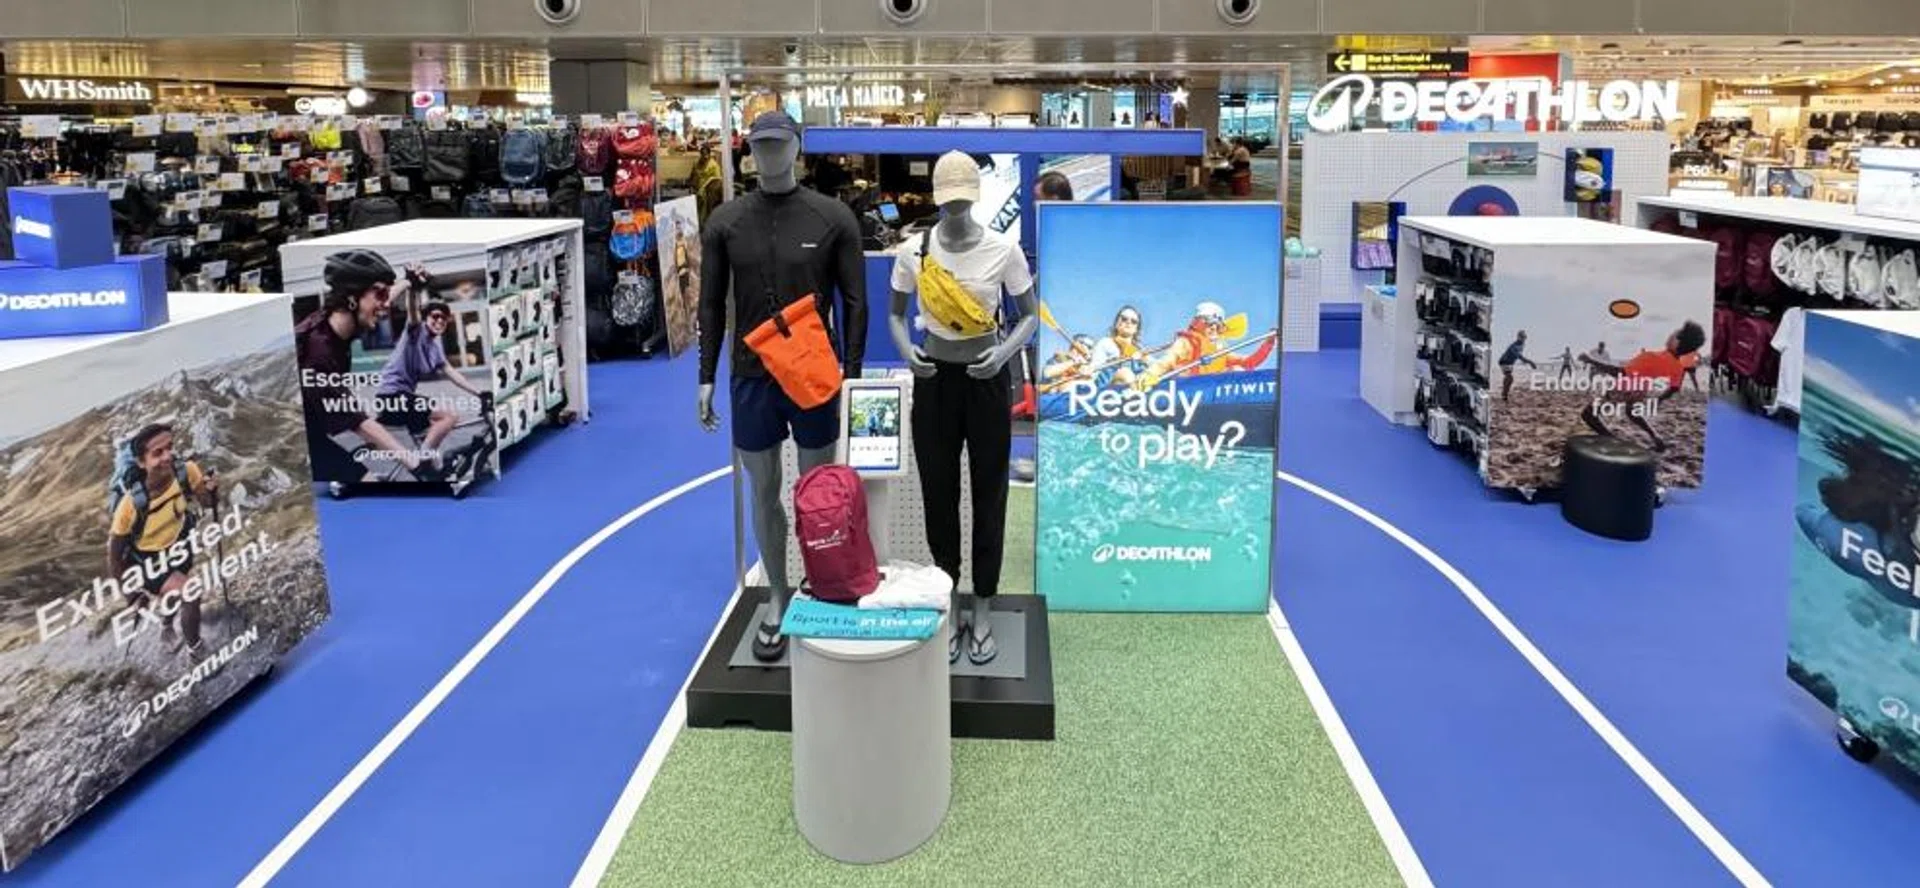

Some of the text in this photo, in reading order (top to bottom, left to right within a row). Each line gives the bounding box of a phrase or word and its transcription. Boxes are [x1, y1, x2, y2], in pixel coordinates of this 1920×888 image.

[19, 78, 151, 100] WHSmith
[1380, 79, 1679, 121] DECATHLON
[10, 291, 125, 310] DECATHLON
[302, 368, 383, 393] Escape
[1216, 381, 1277, 398] ITIWIT
[1530, 372, 1671, 394] Endorphins
[323, 394, 482, 413] without aches
[1068, 380, 1204, 426] Ready
[1592, 398, 1658, 417] for all
[370, 451, 441, 460] DECATHLON
[1100, 420, 1246, 470] to play?
[1116, 546, 1212, 562] DECATHLON
[35, 503, 251, 642] Exhausted.
[110, 529, 278, 648] Excellent.
[792, 613, 838, 624] Sport
[859, 617, 878, 627] in
[881, 617, 908, 627] the
[151, 624, 258, 714] DECATHLON
